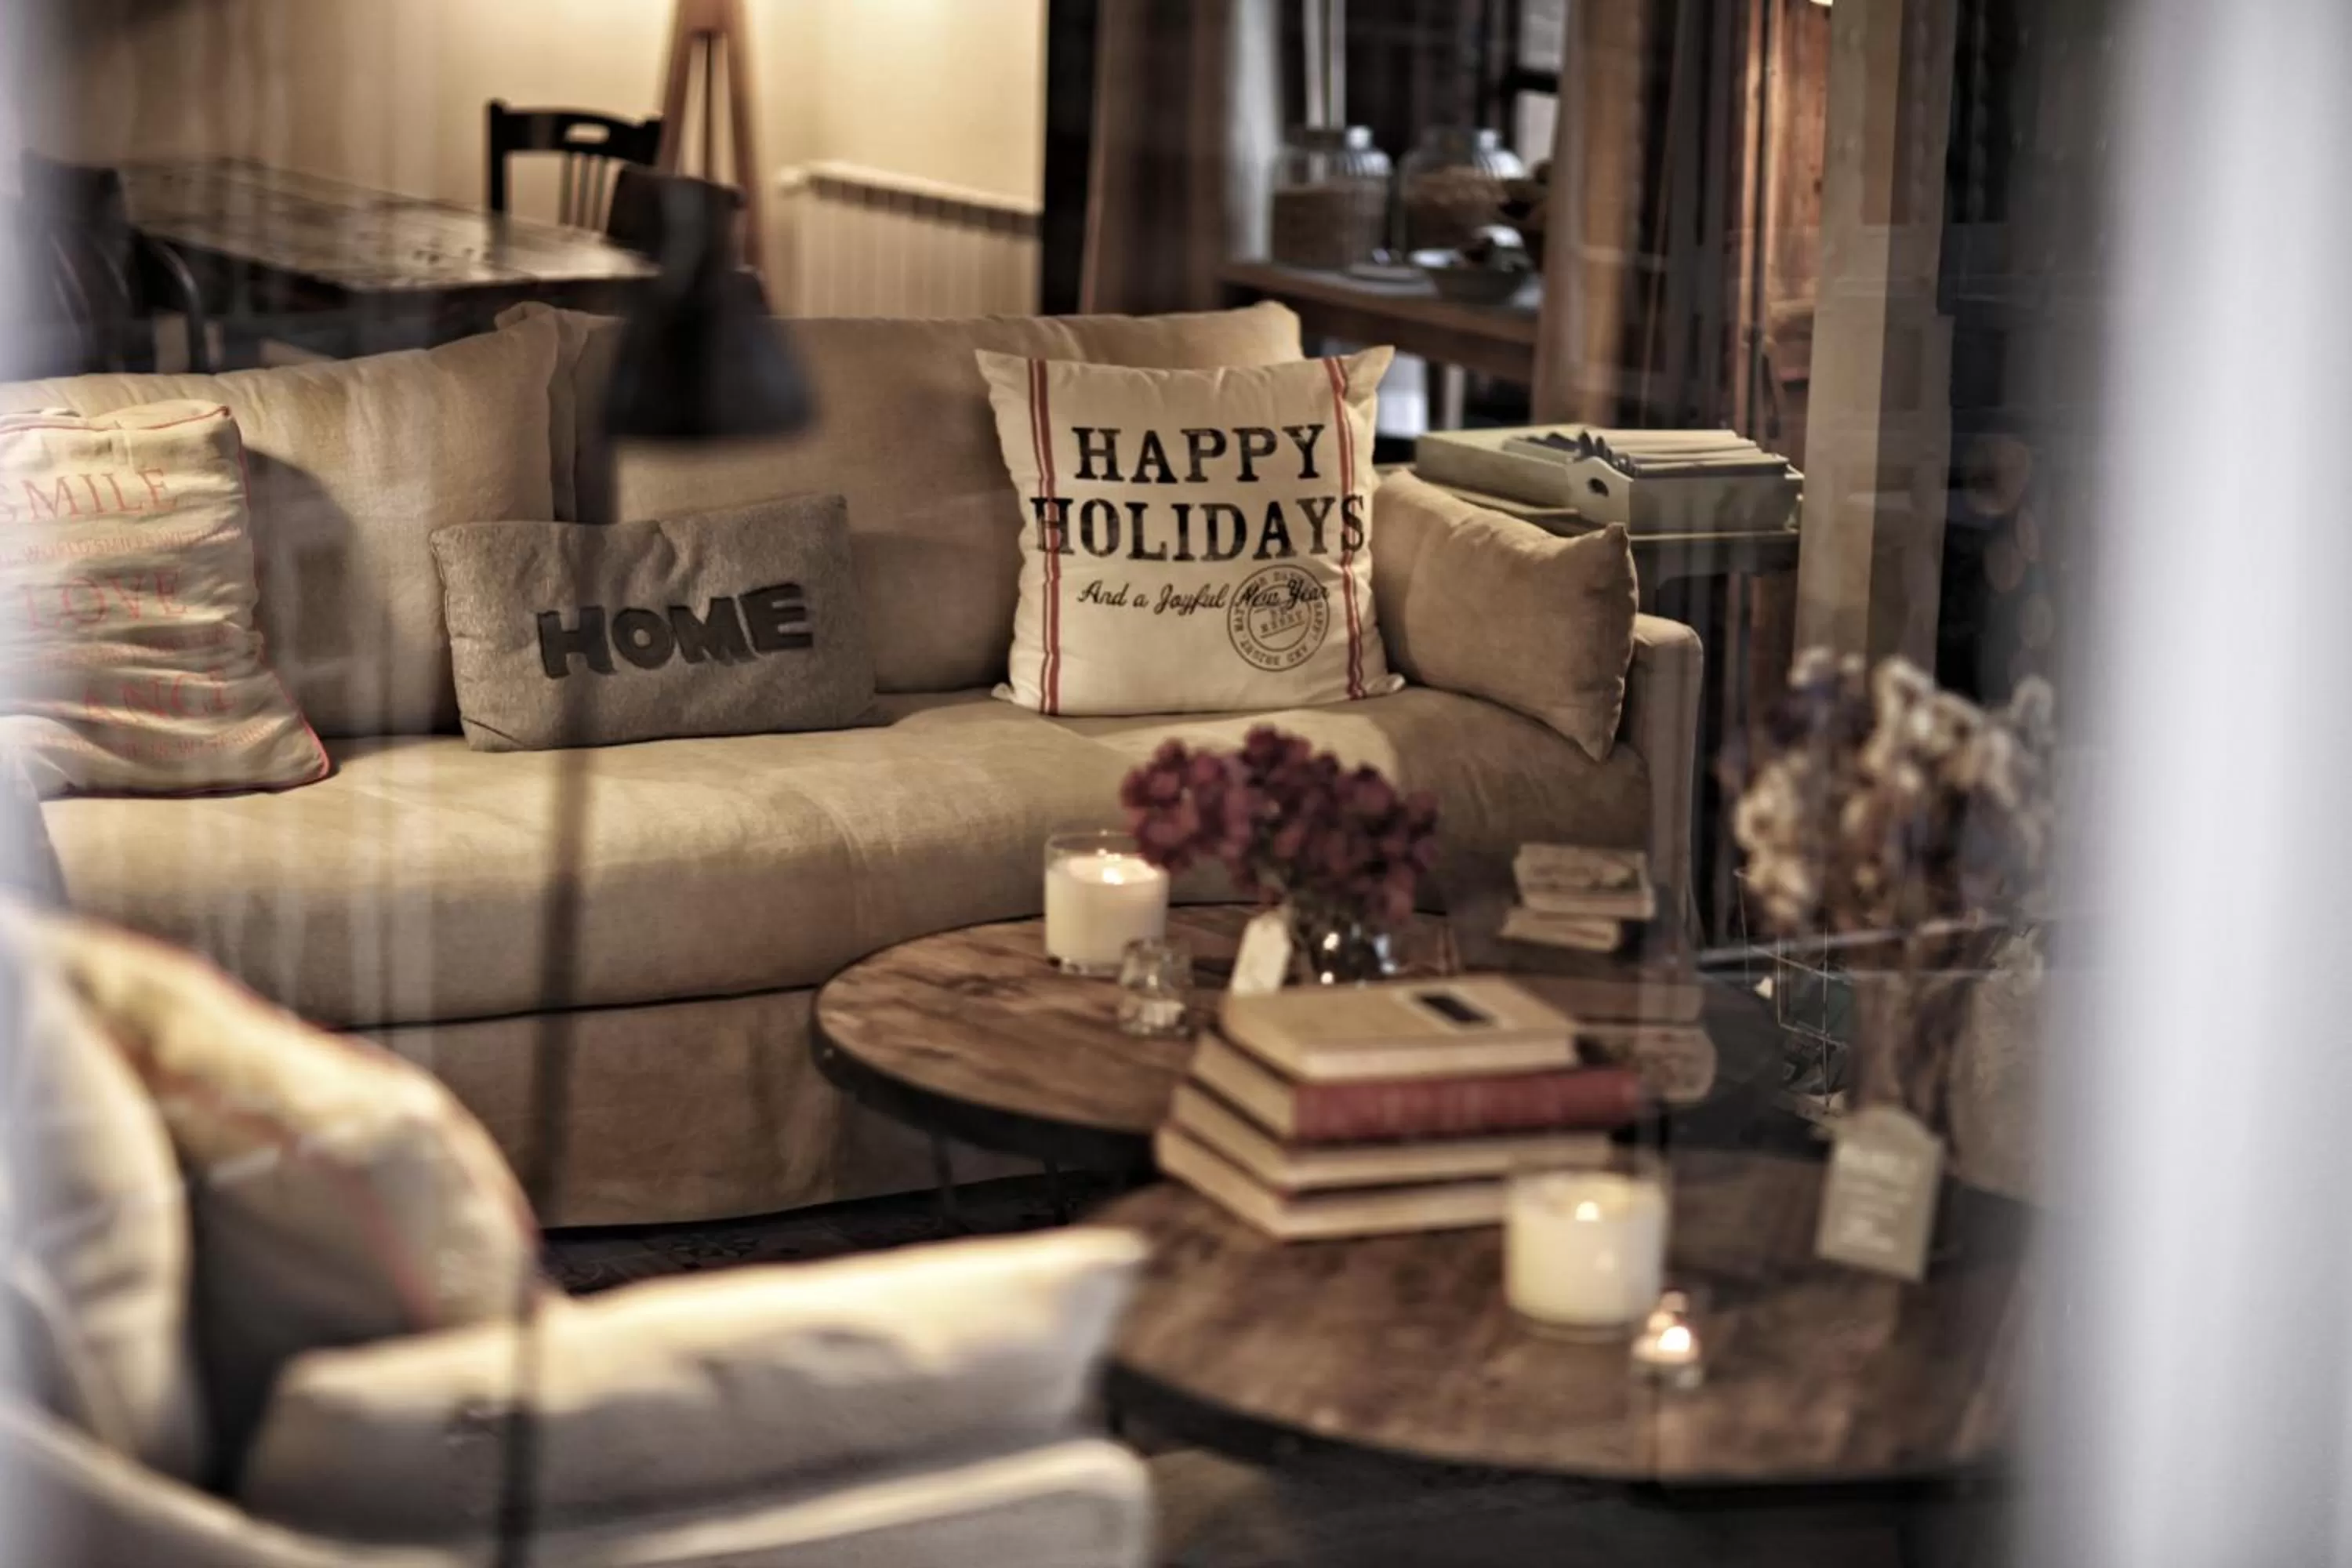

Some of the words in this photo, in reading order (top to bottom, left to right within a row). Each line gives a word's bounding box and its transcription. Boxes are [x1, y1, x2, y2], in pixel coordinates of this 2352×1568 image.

[1071, 424, 1325, 484] HAPPY
[1029, 493, 1365, 562] HOLIDAYS
[20, 568, 188, 630] LOVE
[1076, 579, 1129, 608] And
[1133, 590, 1149, 608] a
[1153, 583, 1230, 616] Joyful
[1235, 580, 1280, 607] New
[1284, 578, 1330, 611] Year
[536, 583, 813, 679] HOME
[52, 664, 237, 726] ANCE
